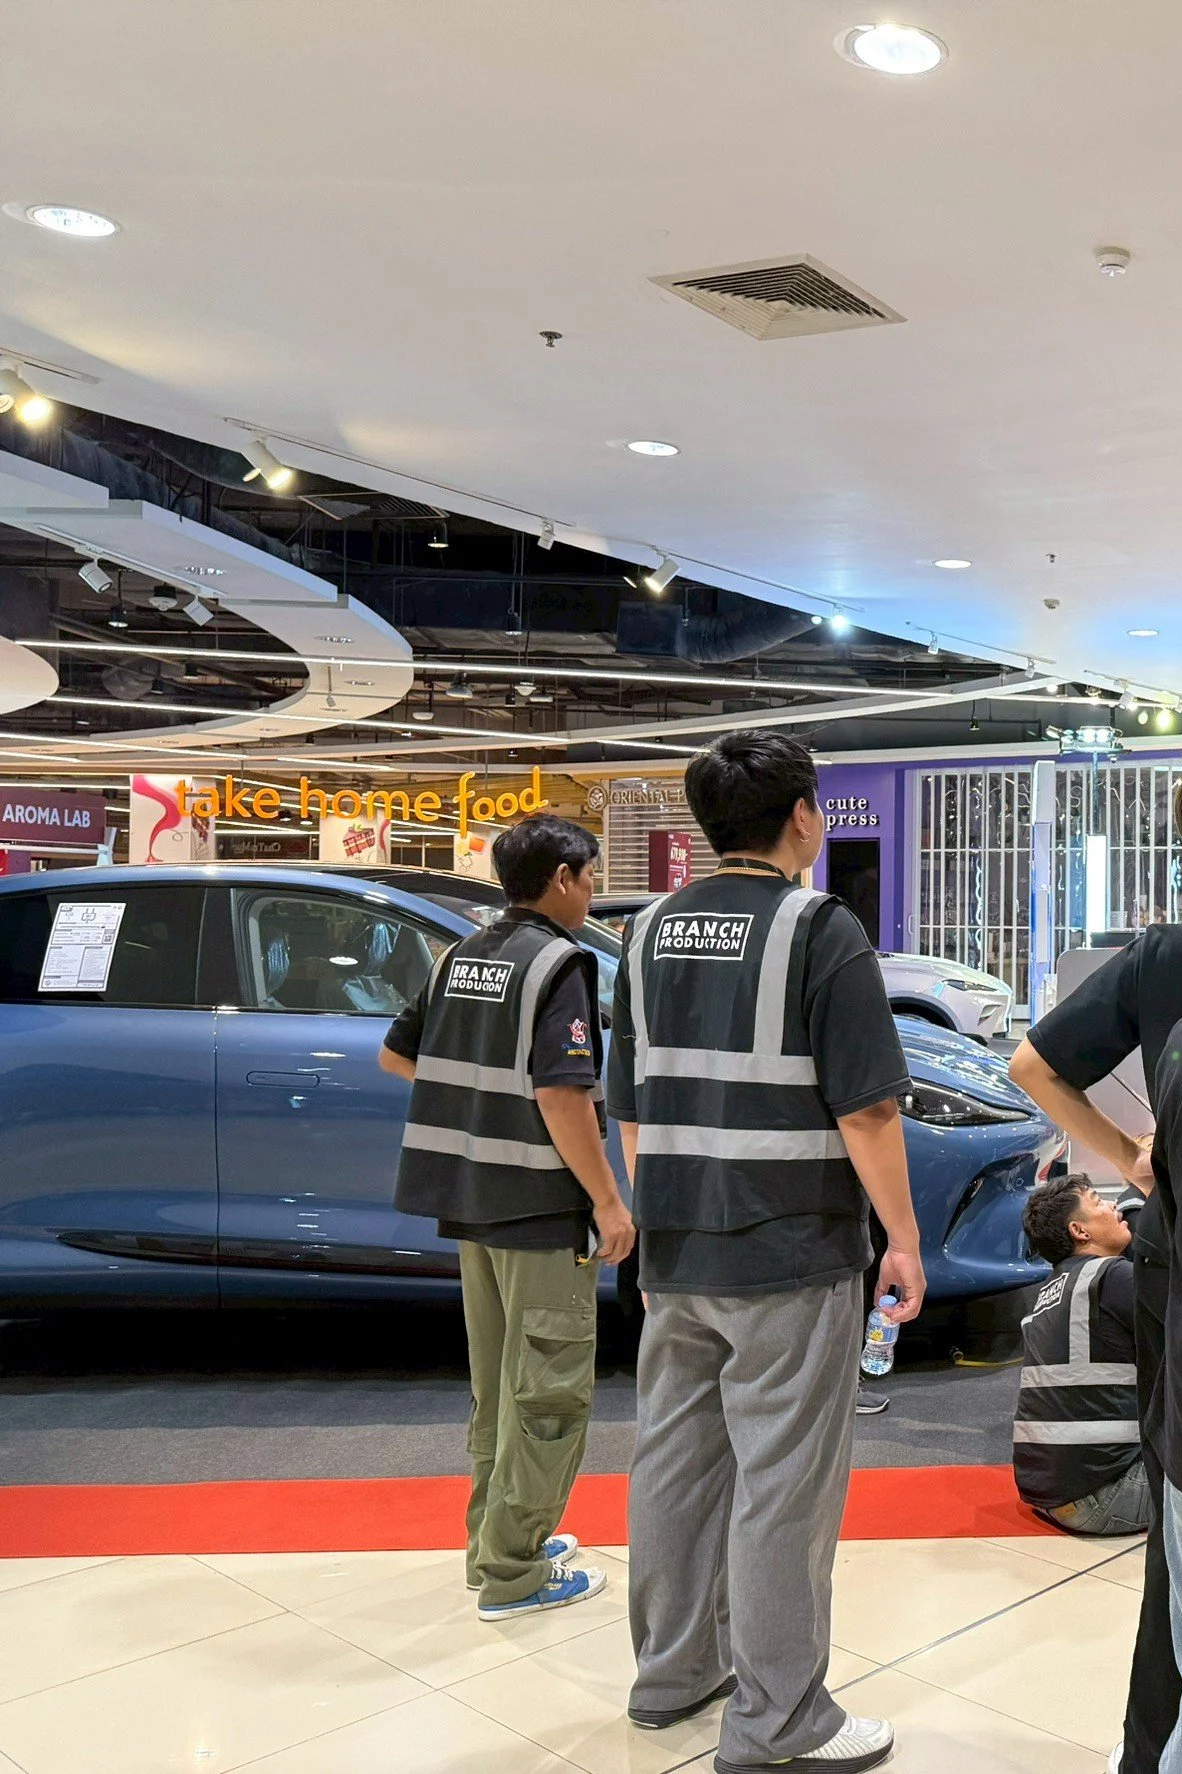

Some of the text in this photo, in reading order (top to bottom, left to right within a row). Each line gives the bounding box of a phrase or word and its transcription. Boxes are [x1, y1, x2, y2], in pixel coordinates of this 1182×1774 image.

[174, 766, 549, 839] take home food
[610, 789, 671, 805] ORIENTAL
[826, 796, 868, 810] cute
[2, 803, 91, 828] AROMA LAB
[826, 813, 878, 831] press
[662, 920, 745, 938] BRANCH
[659, 937, 741, 950] PRODUCTION
